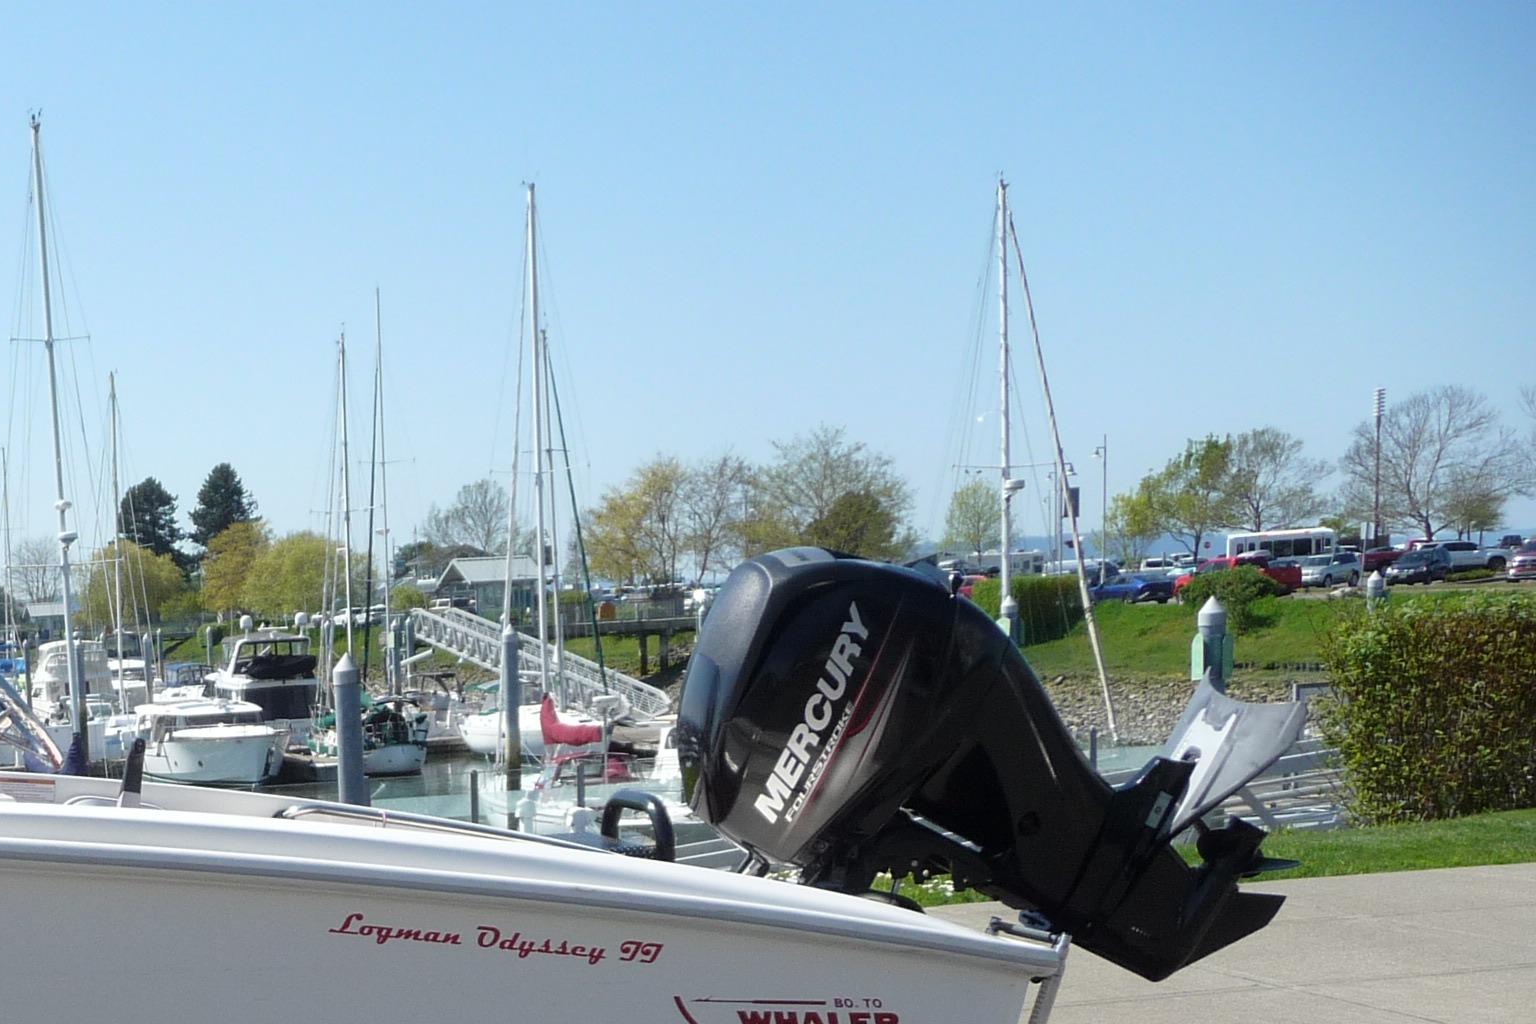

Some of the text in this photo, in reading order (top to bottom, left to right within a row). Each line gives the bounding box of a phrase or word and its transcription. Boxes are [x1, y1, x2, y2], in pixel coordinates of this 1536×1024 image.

[754, 601, 869, 824] MERCURY
[785, 700, 856, 822] FOURSTROKE
[328, 913, 664, 964] Logman Odyssey II
